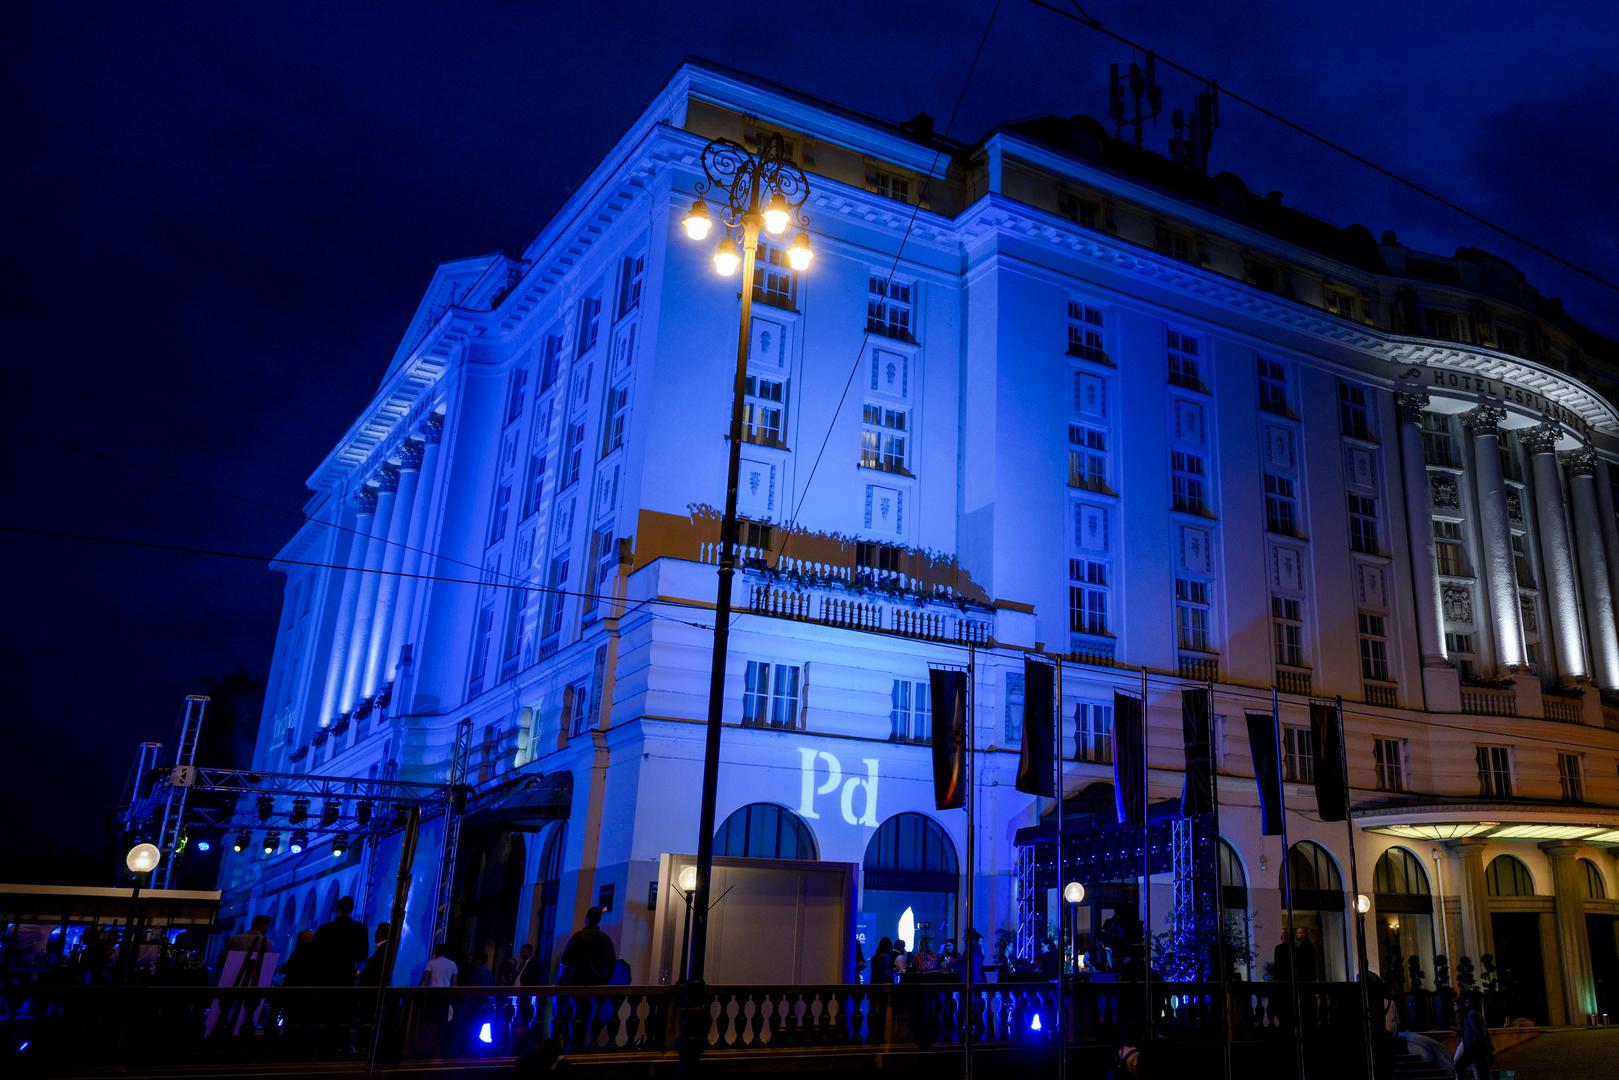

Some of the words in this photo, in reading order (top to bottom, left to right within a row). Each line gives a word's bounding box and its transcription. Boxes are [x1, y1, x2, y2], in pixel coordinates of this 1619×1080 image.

[1435, 371, 1497, 395] HOTEL
[1504, 386, 1580, 431] ESPLANADE
[797, 746, 879, 828] Pd
